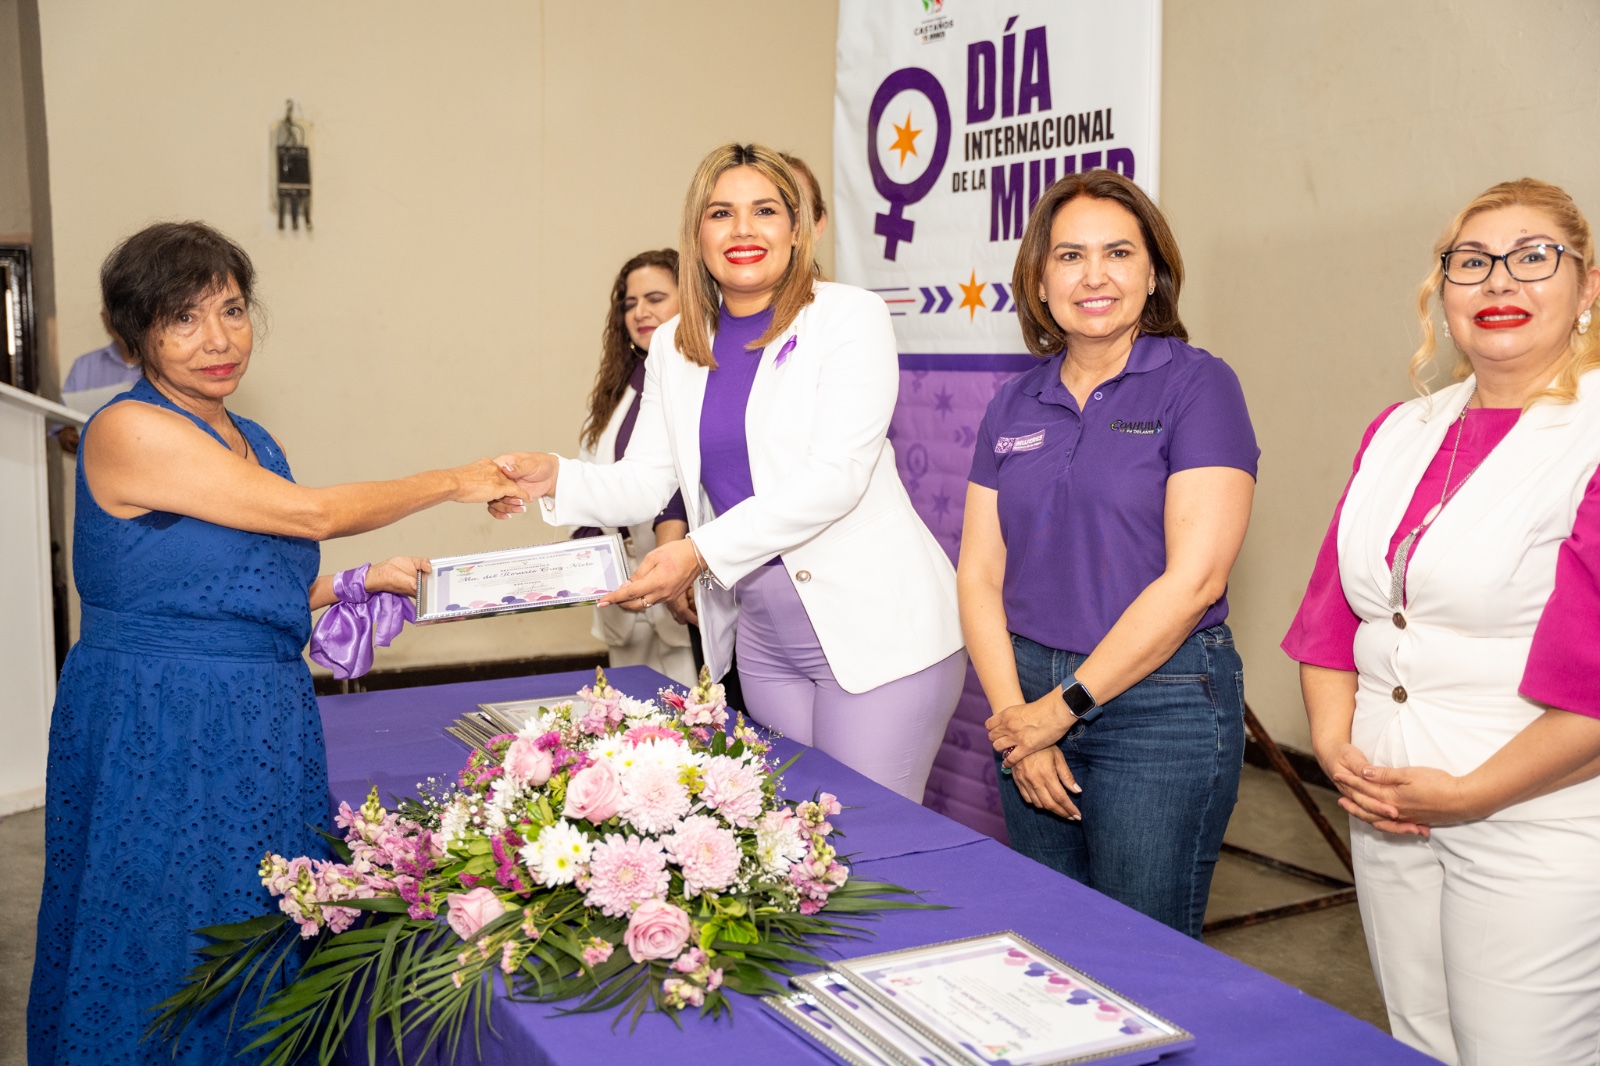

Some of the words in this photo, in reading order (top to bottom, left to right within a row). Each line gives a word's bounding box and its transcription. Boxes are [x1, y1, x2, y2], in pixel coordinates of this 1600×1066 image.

[966, 15, 1052, 125] DÍA
[965, 108, 1115, 162] INTERNACIONAL
[952, 171, 968, 193] DE
[971, 169, 986, 191] LA
